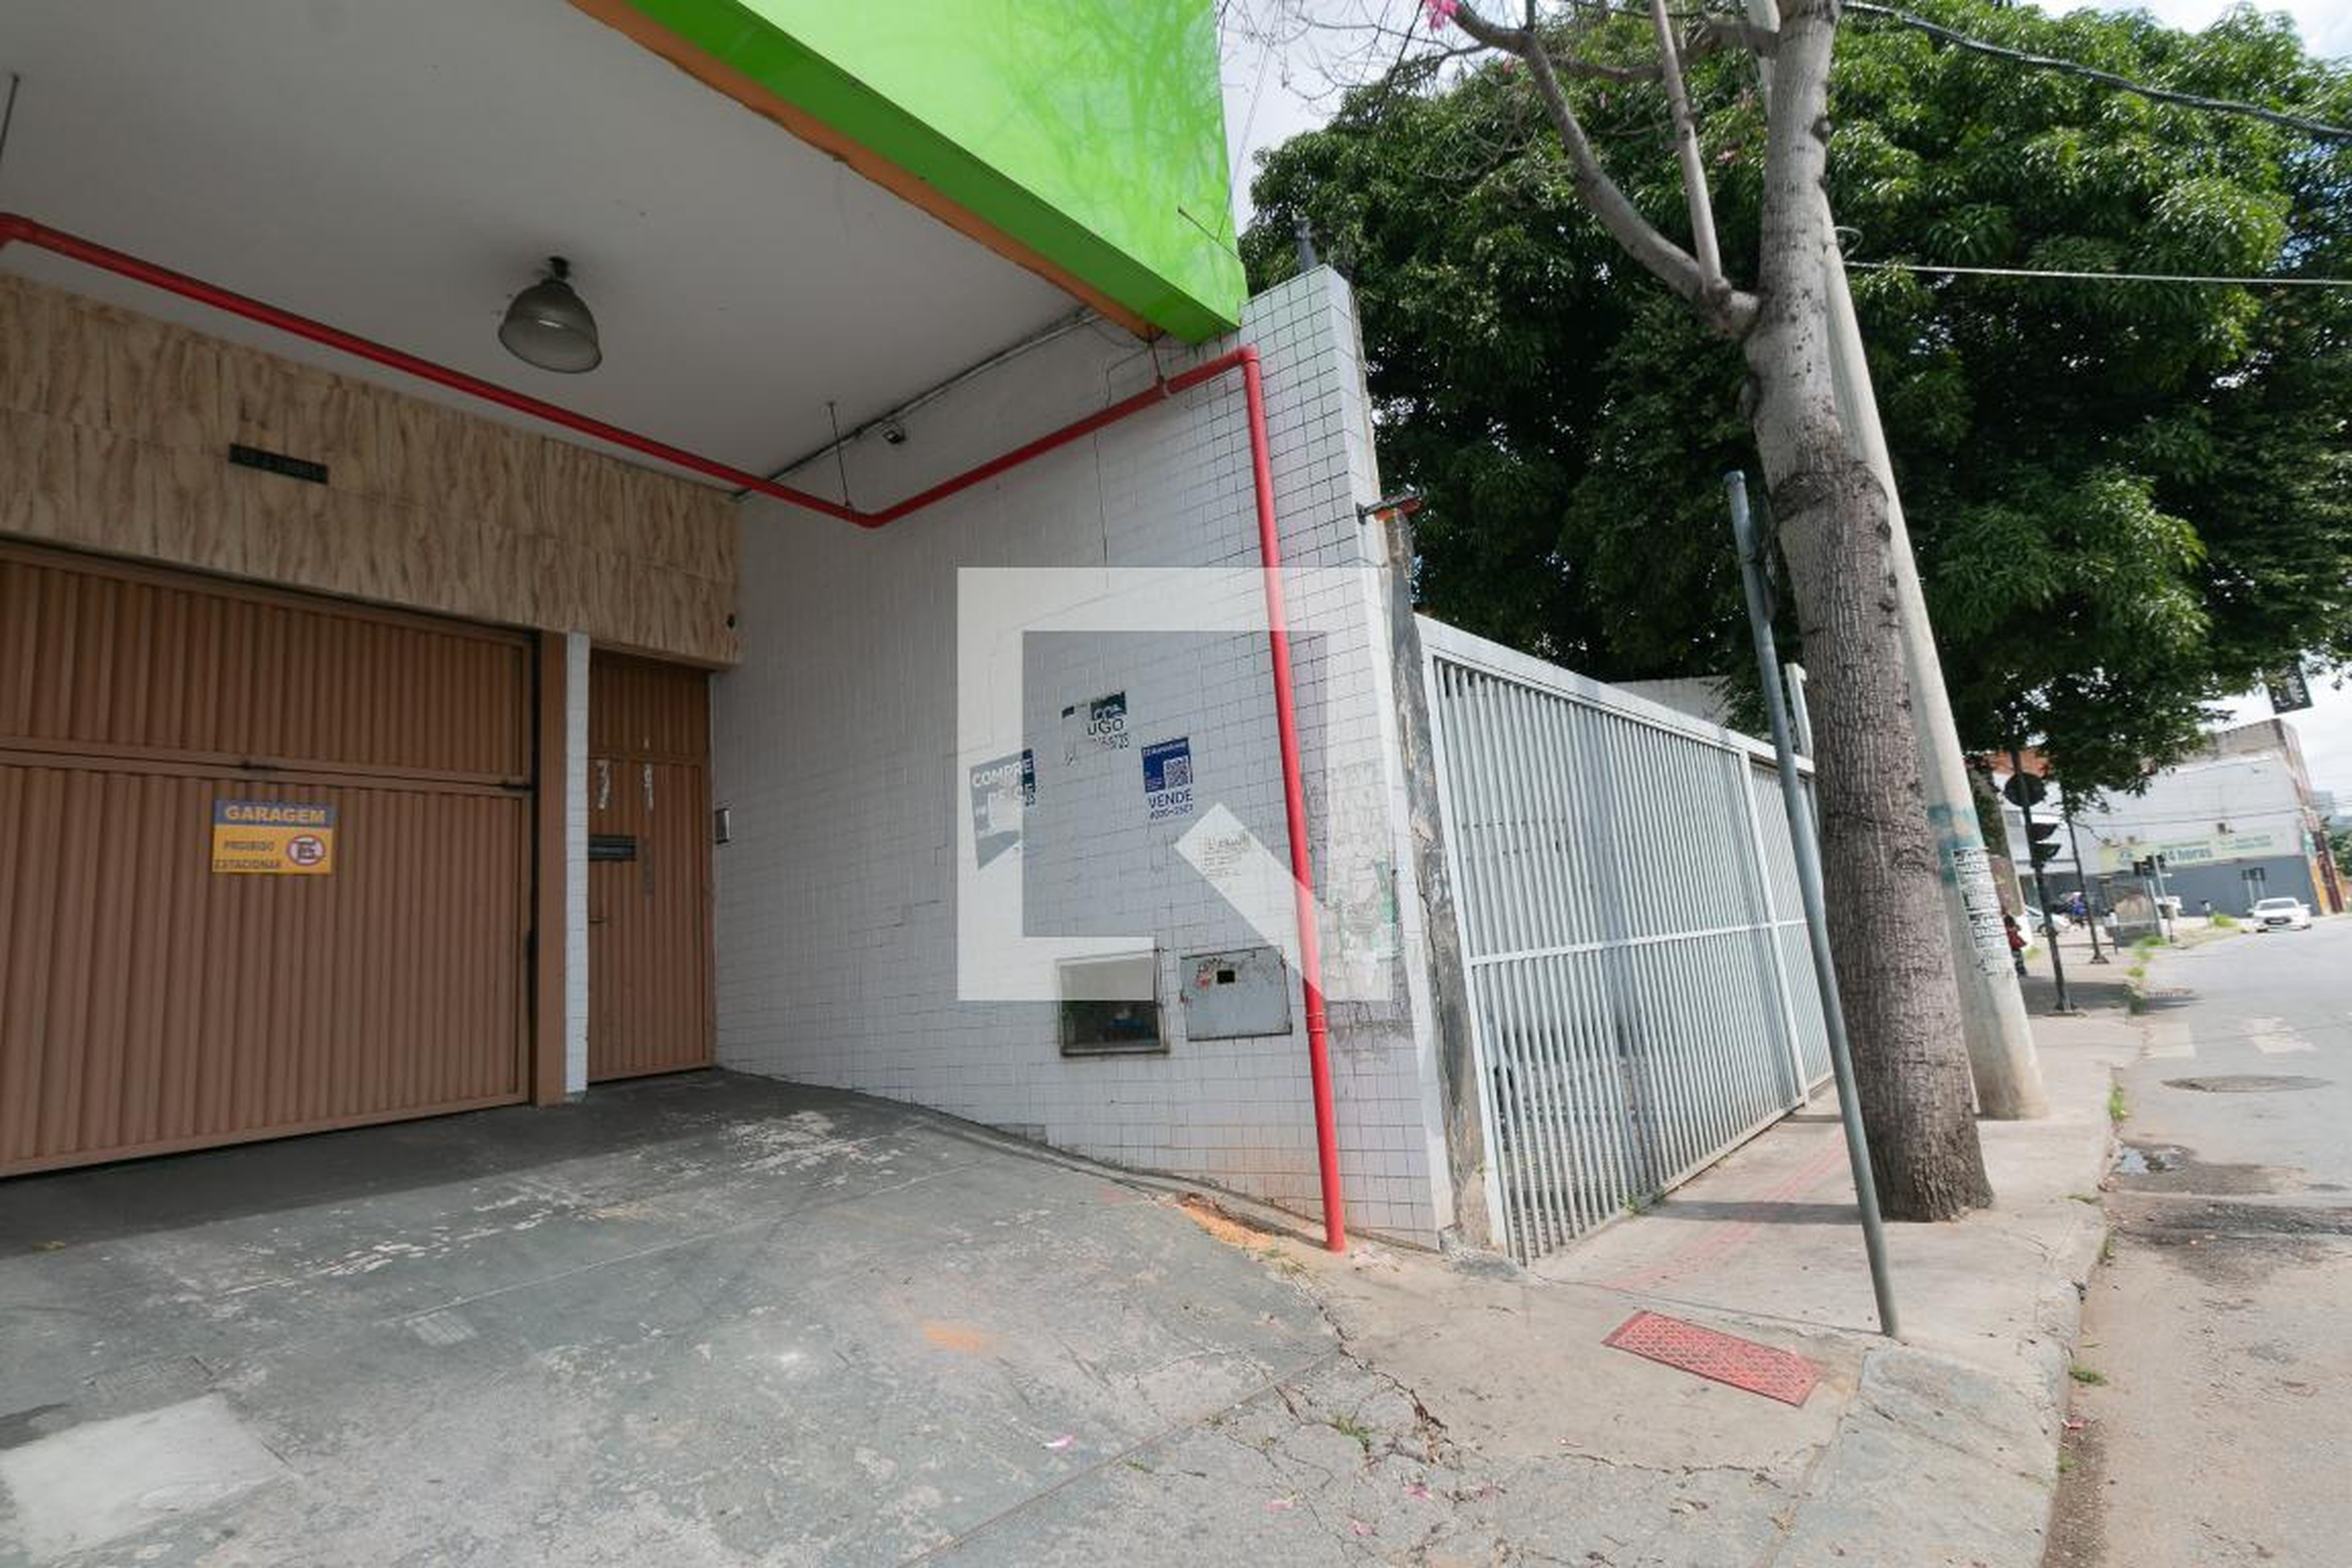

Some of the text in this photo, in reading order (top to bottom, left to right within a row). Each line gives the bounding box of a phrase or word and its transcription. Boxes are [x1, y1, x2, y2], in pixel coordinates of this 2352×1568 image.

[972, 758, 1033, 788] COMPRE
[1148, 789, 1193, 809] VENDE
[225, 805, 326, 823] GARAGEM
